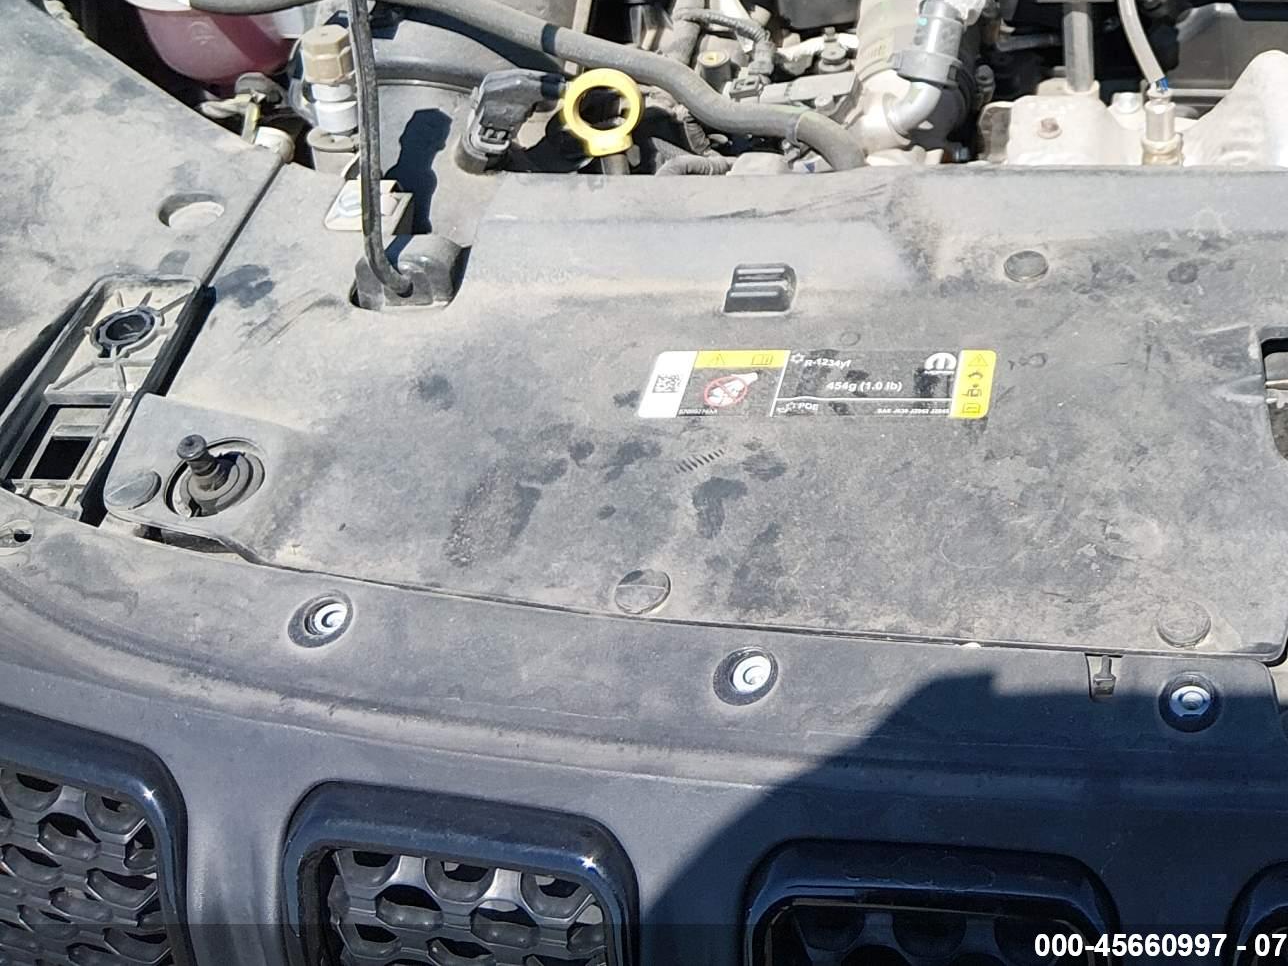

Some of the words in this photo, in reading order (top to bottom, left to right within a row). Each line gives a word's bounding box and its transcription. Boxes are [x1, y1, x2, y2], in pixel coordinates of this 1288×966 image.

[804, 357, 853, 371] R-1234yf
[826, 381, 858, 392] 454g
[860, 380, 884, 393] (1.0
[885, 380, 903, 393] lb)
[798, 402, 820, 412] POE
